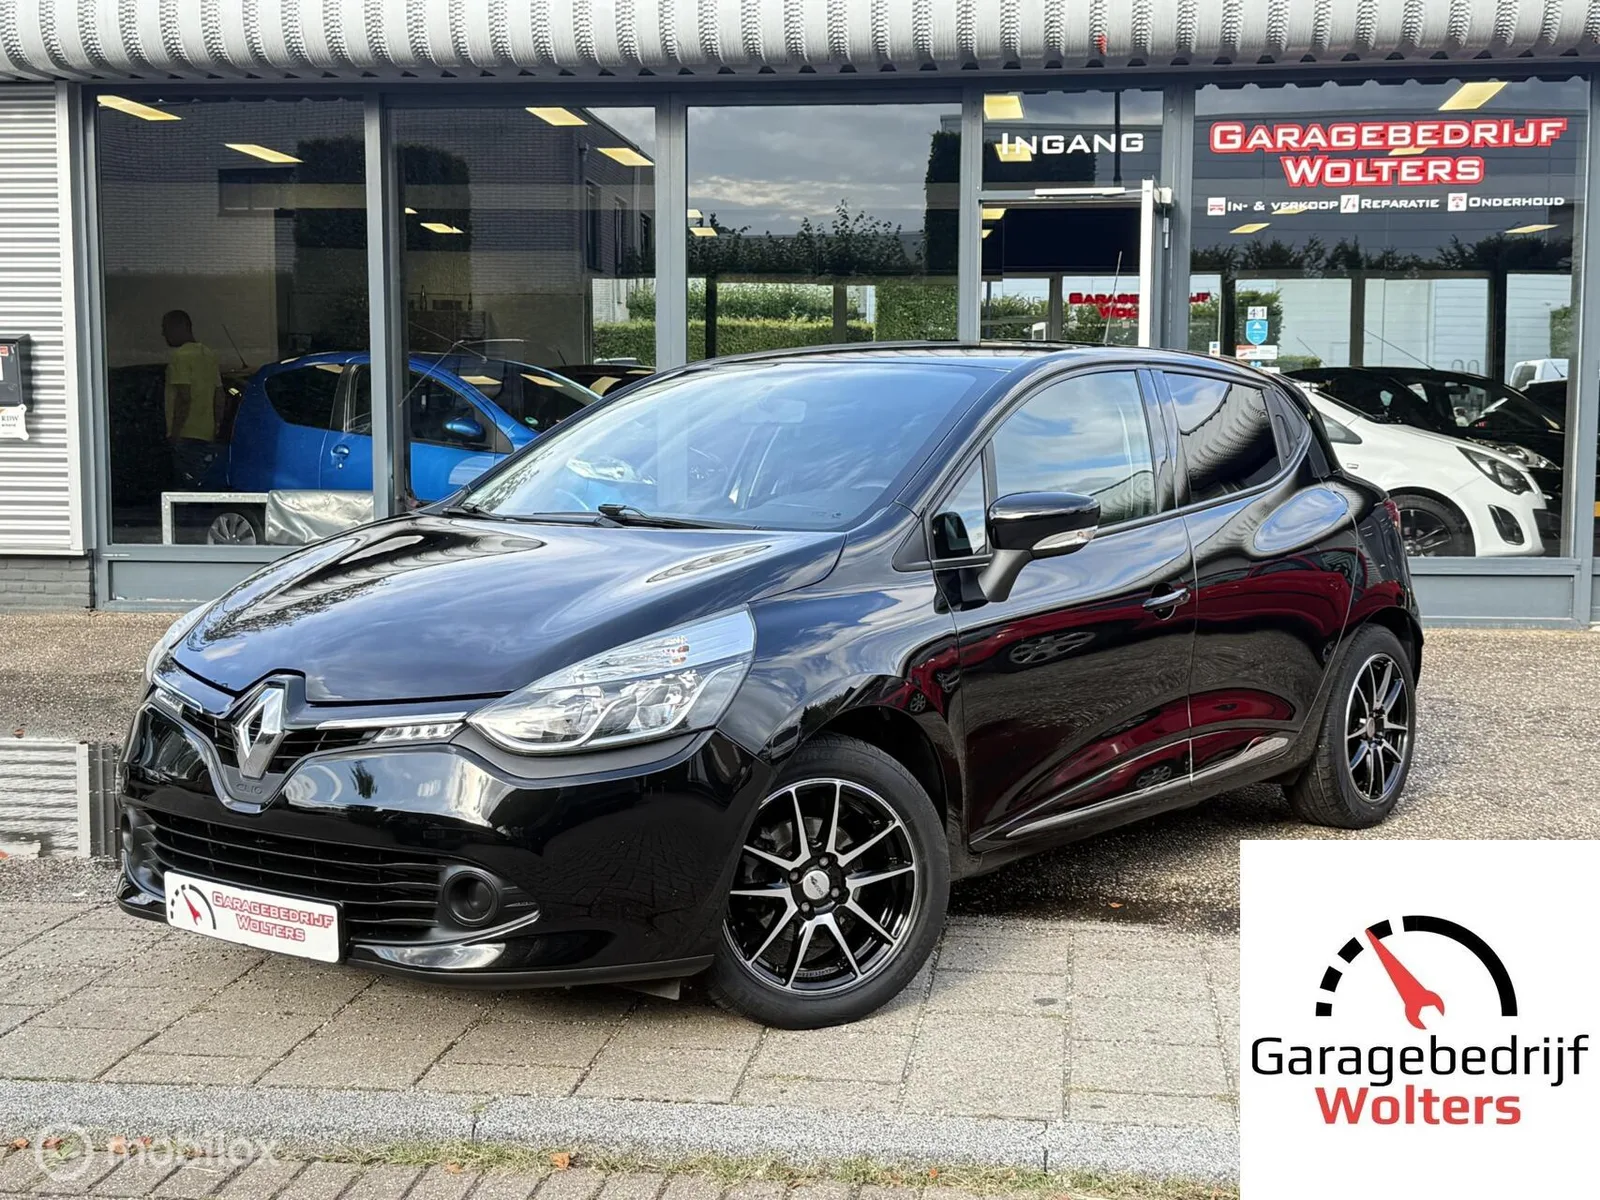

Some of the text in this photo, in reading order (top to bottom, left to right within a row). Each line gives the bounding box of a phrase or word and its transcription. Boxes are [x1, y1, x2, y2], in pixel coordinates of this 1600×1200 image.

[1002, 132, 1144, 155] INGANG
[1210, 118, 1567, 152] GARAGEBEDRIJF
[1280, 155, 1484, 187] WOLTERS
[1253, 201, 1265, 211] &
[1270, 199, 1339, 210] VERKOOP
[1361, 198, 1440, 209] REPARATIE
[1468, 196, 1565, 207] ONDERHOUD
[236, 783, 263, 794] CLIO
[212, 891, 334, 928] GARAGEBEDRIJF
[236, 913, 306, 942] WOLTERS
